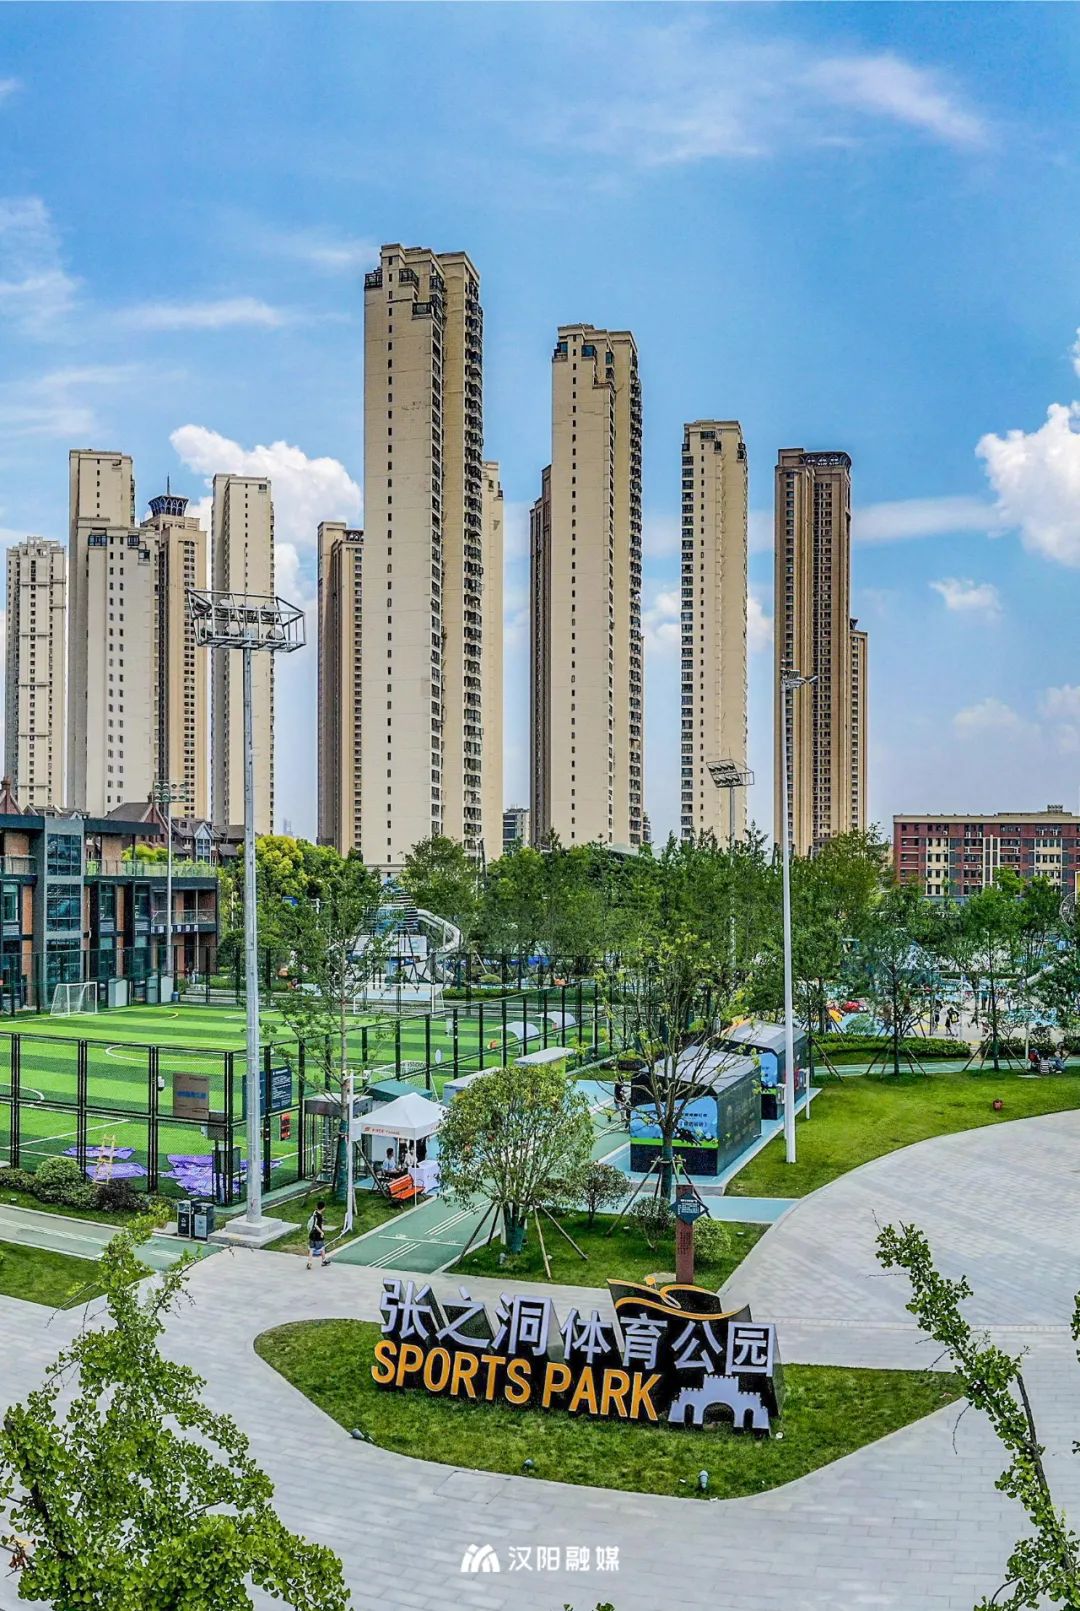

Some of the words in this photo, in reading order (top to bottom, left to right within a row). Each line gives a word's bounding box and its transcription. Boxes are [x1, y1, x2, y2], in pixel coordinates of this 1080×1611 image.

[381, 1278, 775, 1376] 张之洞体育公园
[372, 1340, 532, 1404] SPORTS
[542, 1362, 662, 1422] PARK
